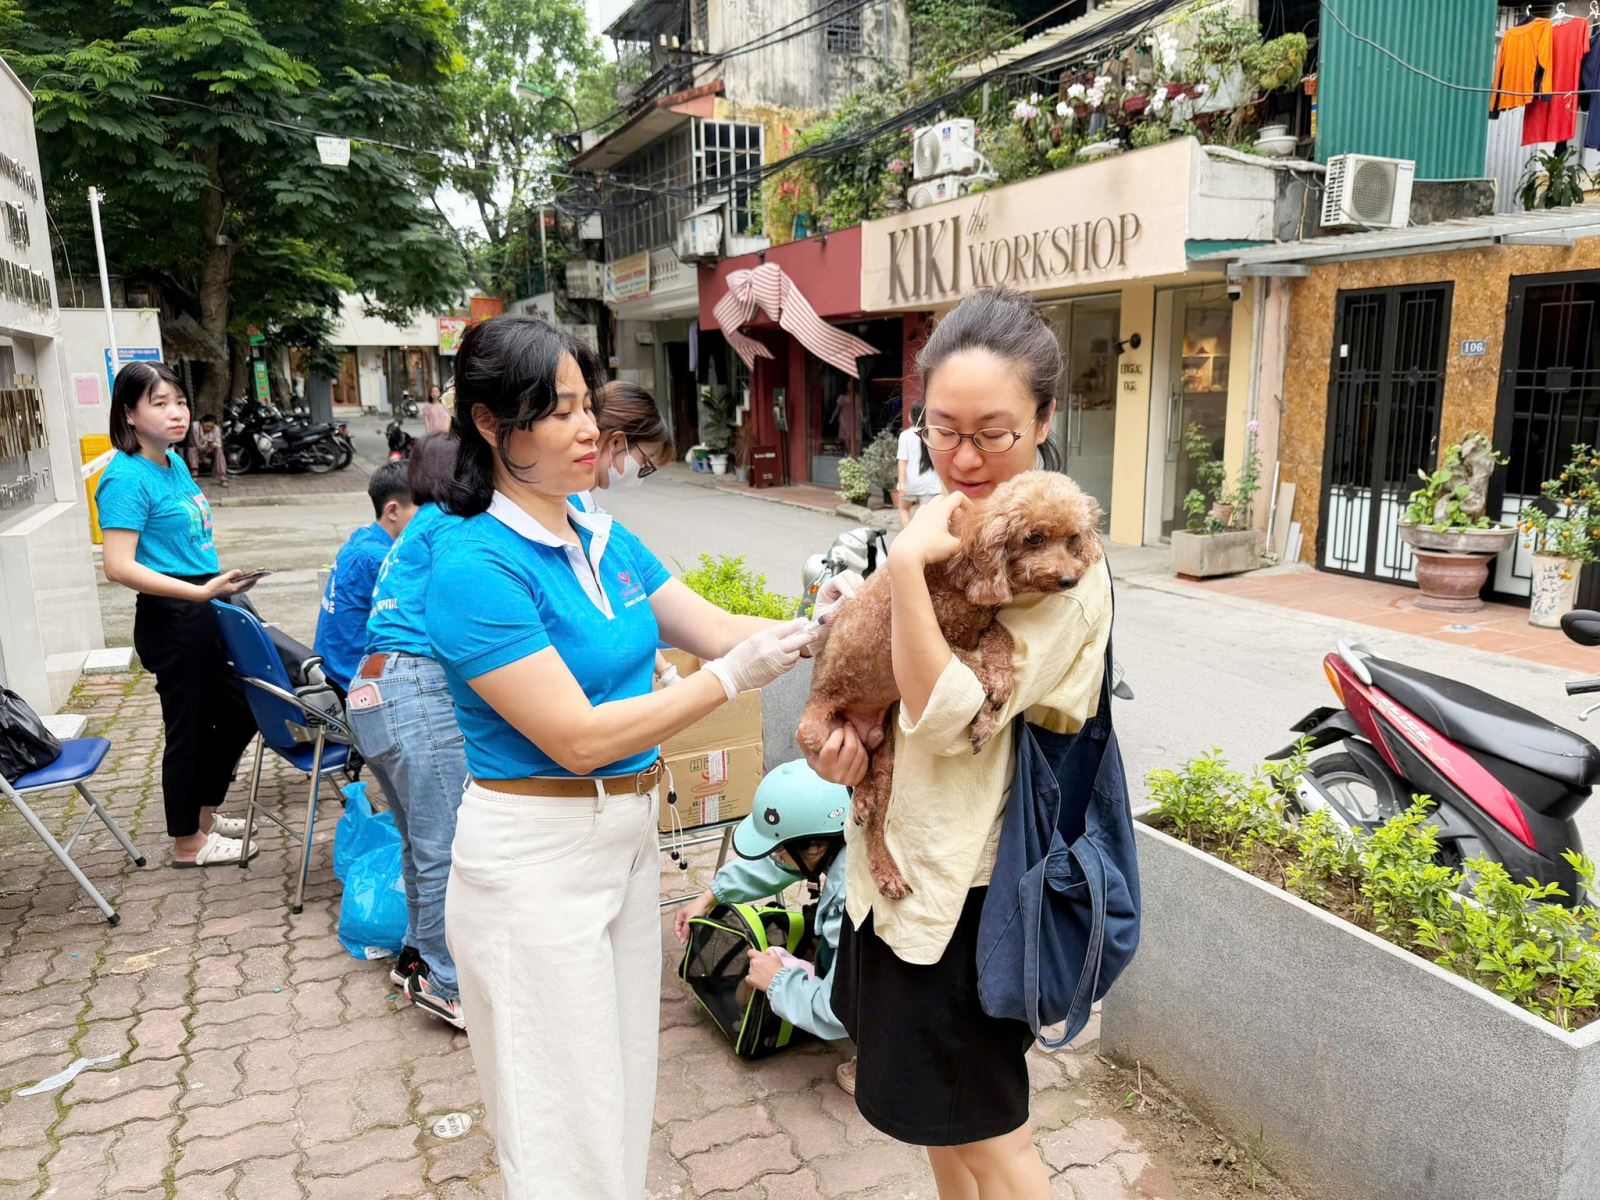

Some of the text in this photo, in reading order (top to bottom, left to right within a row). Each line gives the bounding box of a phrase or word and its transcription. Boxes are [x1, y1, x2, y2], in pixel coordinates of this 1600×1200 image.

[888, 194, 1142, 304] KIKI the WORKSHOP
[1464, 342, 1484, 353] 106
